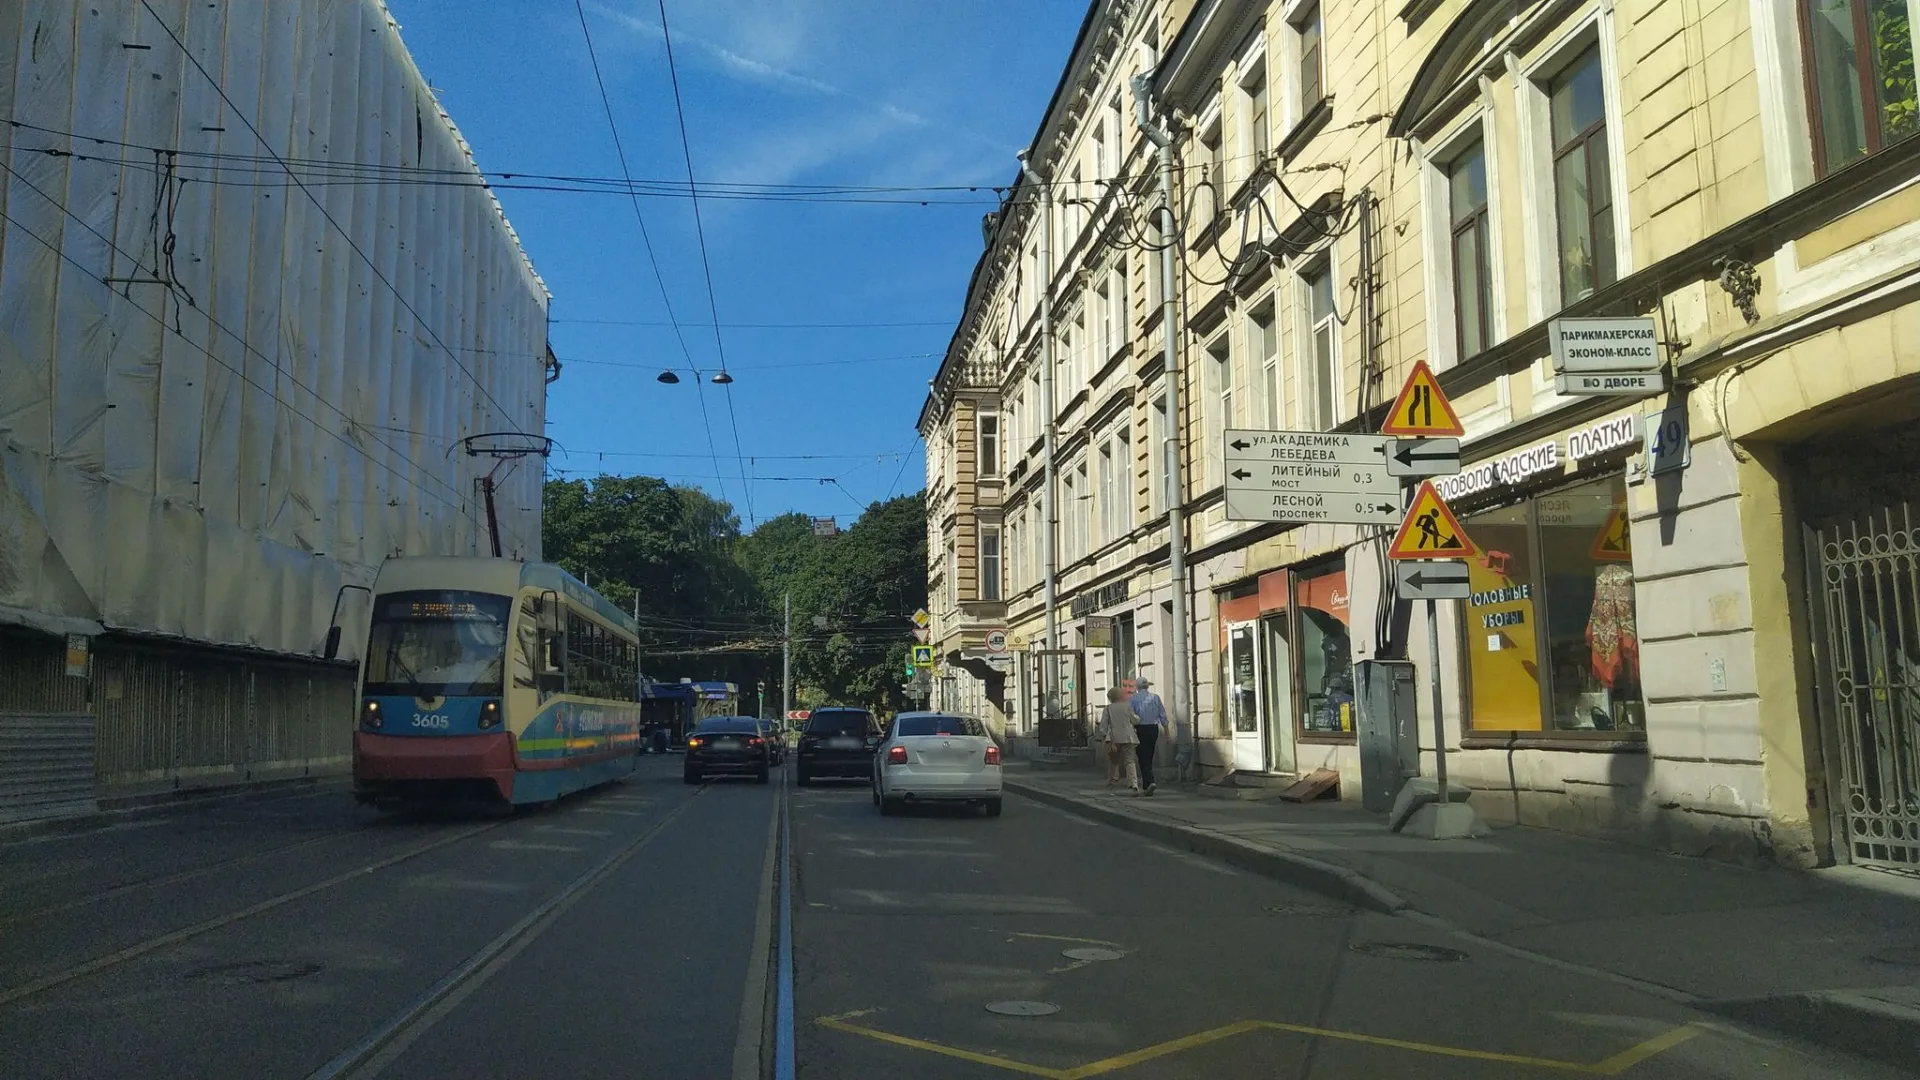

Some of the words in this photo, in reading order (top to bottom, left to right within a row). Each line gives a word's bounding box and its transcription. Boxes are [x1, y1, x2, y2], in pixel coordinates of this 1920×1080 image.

[1561, 329, 1654, 341] ПАРИКМАХЕРСКАЯ
[1568, 346, 1652, 358] ЭКОНОМ-КЛАСС
[1604, 377, 1646, 389] ДВОРЕ
[1652, 421, 1681, 458] 49
[1270, 448, 1336, 461] ЛЕБЕДЕВА
[1435, 443, 1555, 499] ВЛОВОПОСАДСКИЕ
[1569, 416, 1632, 458] ПЛАТКИ
[1271, 464, 1341, 478] ЛИТЕЙНЫЙ
[1271, 479, 1300, 488] мост
[1353, 473, 1373, 484] 0,3
[1272, 493, 1323, 507] ЛЕСНОЙ
[1272, 509, 1328, 519] проспект
[1355, 502, 1374, 514] 0,5
[1481, 611, 1519, 629] УБОРЫ
[411, 713, 449, 729] 3605
